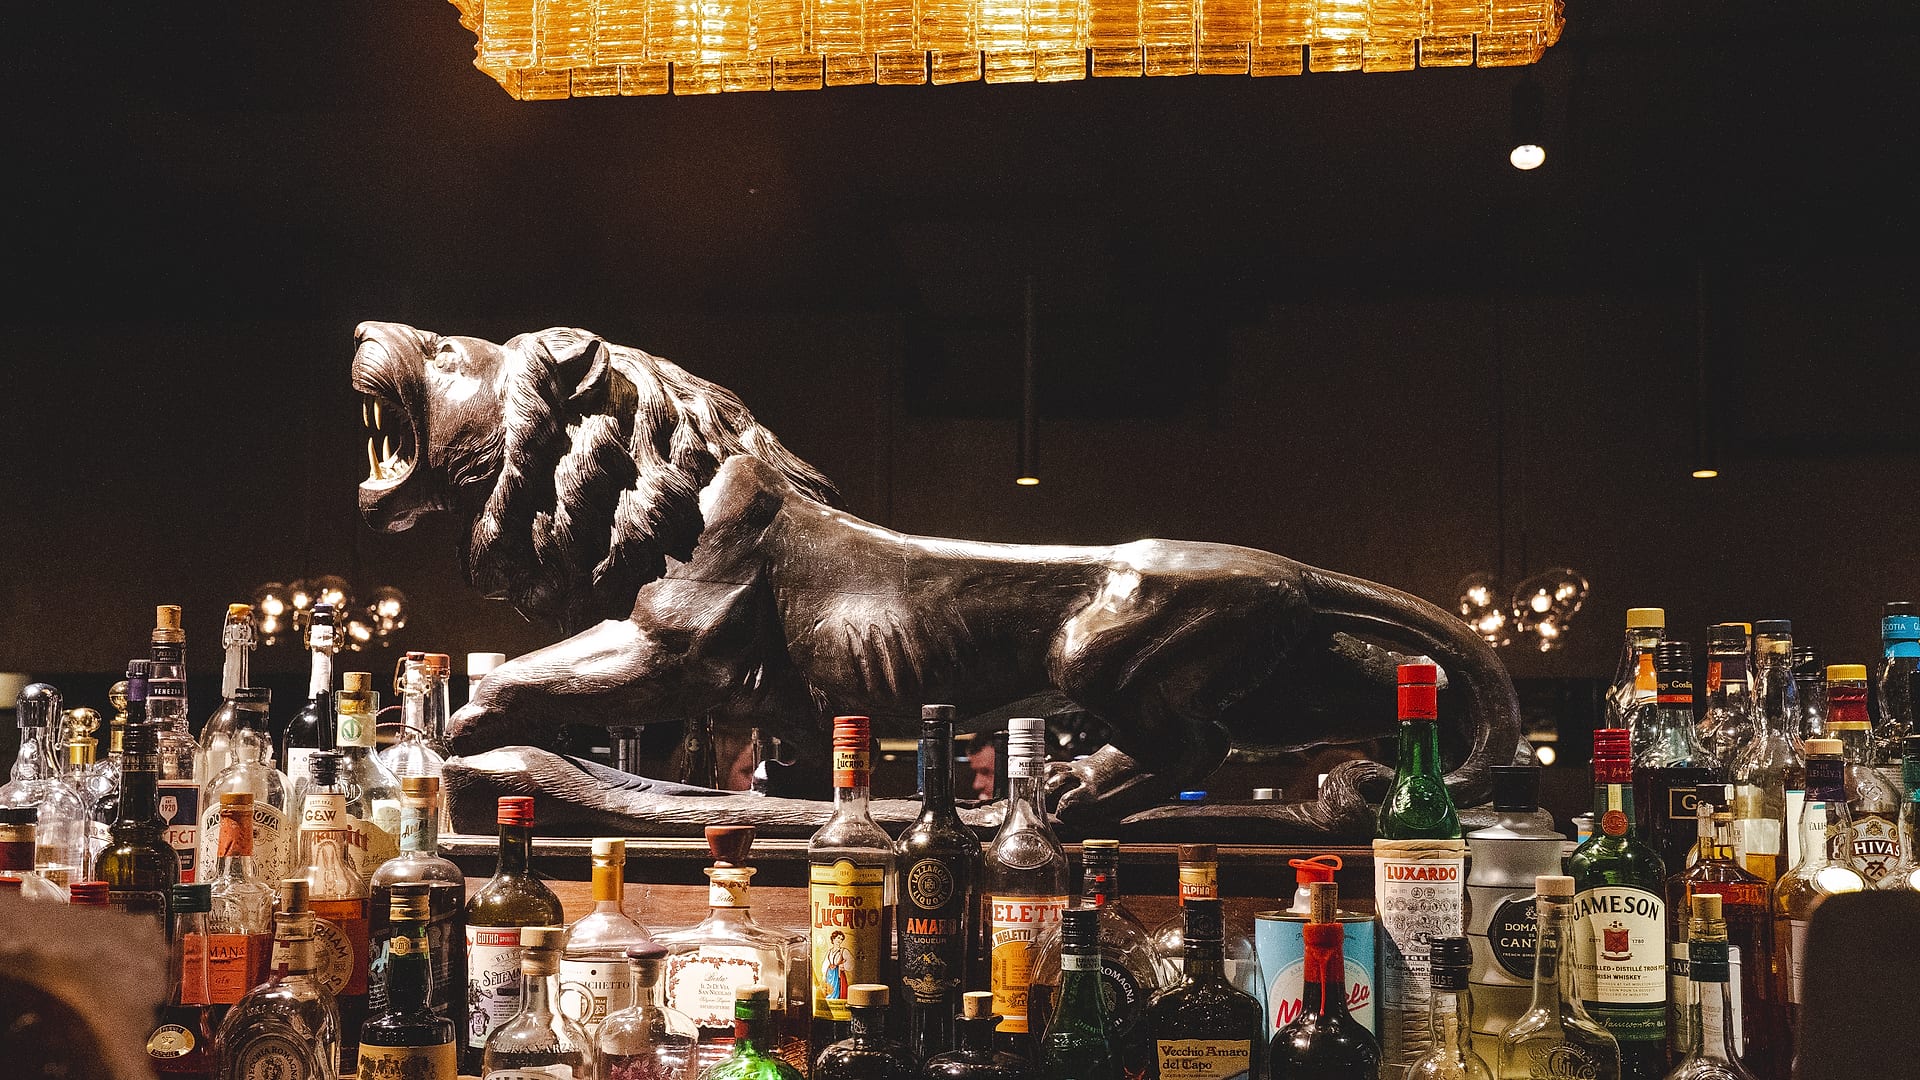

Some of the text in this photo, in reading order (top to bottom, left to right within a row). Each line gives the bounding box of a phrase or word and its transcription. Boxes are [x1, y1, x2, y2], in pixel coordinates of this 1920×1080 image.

[836, 758, 864, 770] LUCANO
[160, 804, 177, 812] 1920
[1386, 866, 1457, 881] LUXARDO
[1182, 886, 1210, 895] ALPINA
[828, 892, 863, 908] AMARO
[1573, 895, 1660, 922] JAMESON
[814, 901, 879, 930] LUCANO
[477, 932, 499, 944] GOTHA
[1159, 1045, 1249, 1058] Vecchio Amaro
[1162, 1058, 1180, 1070] del
